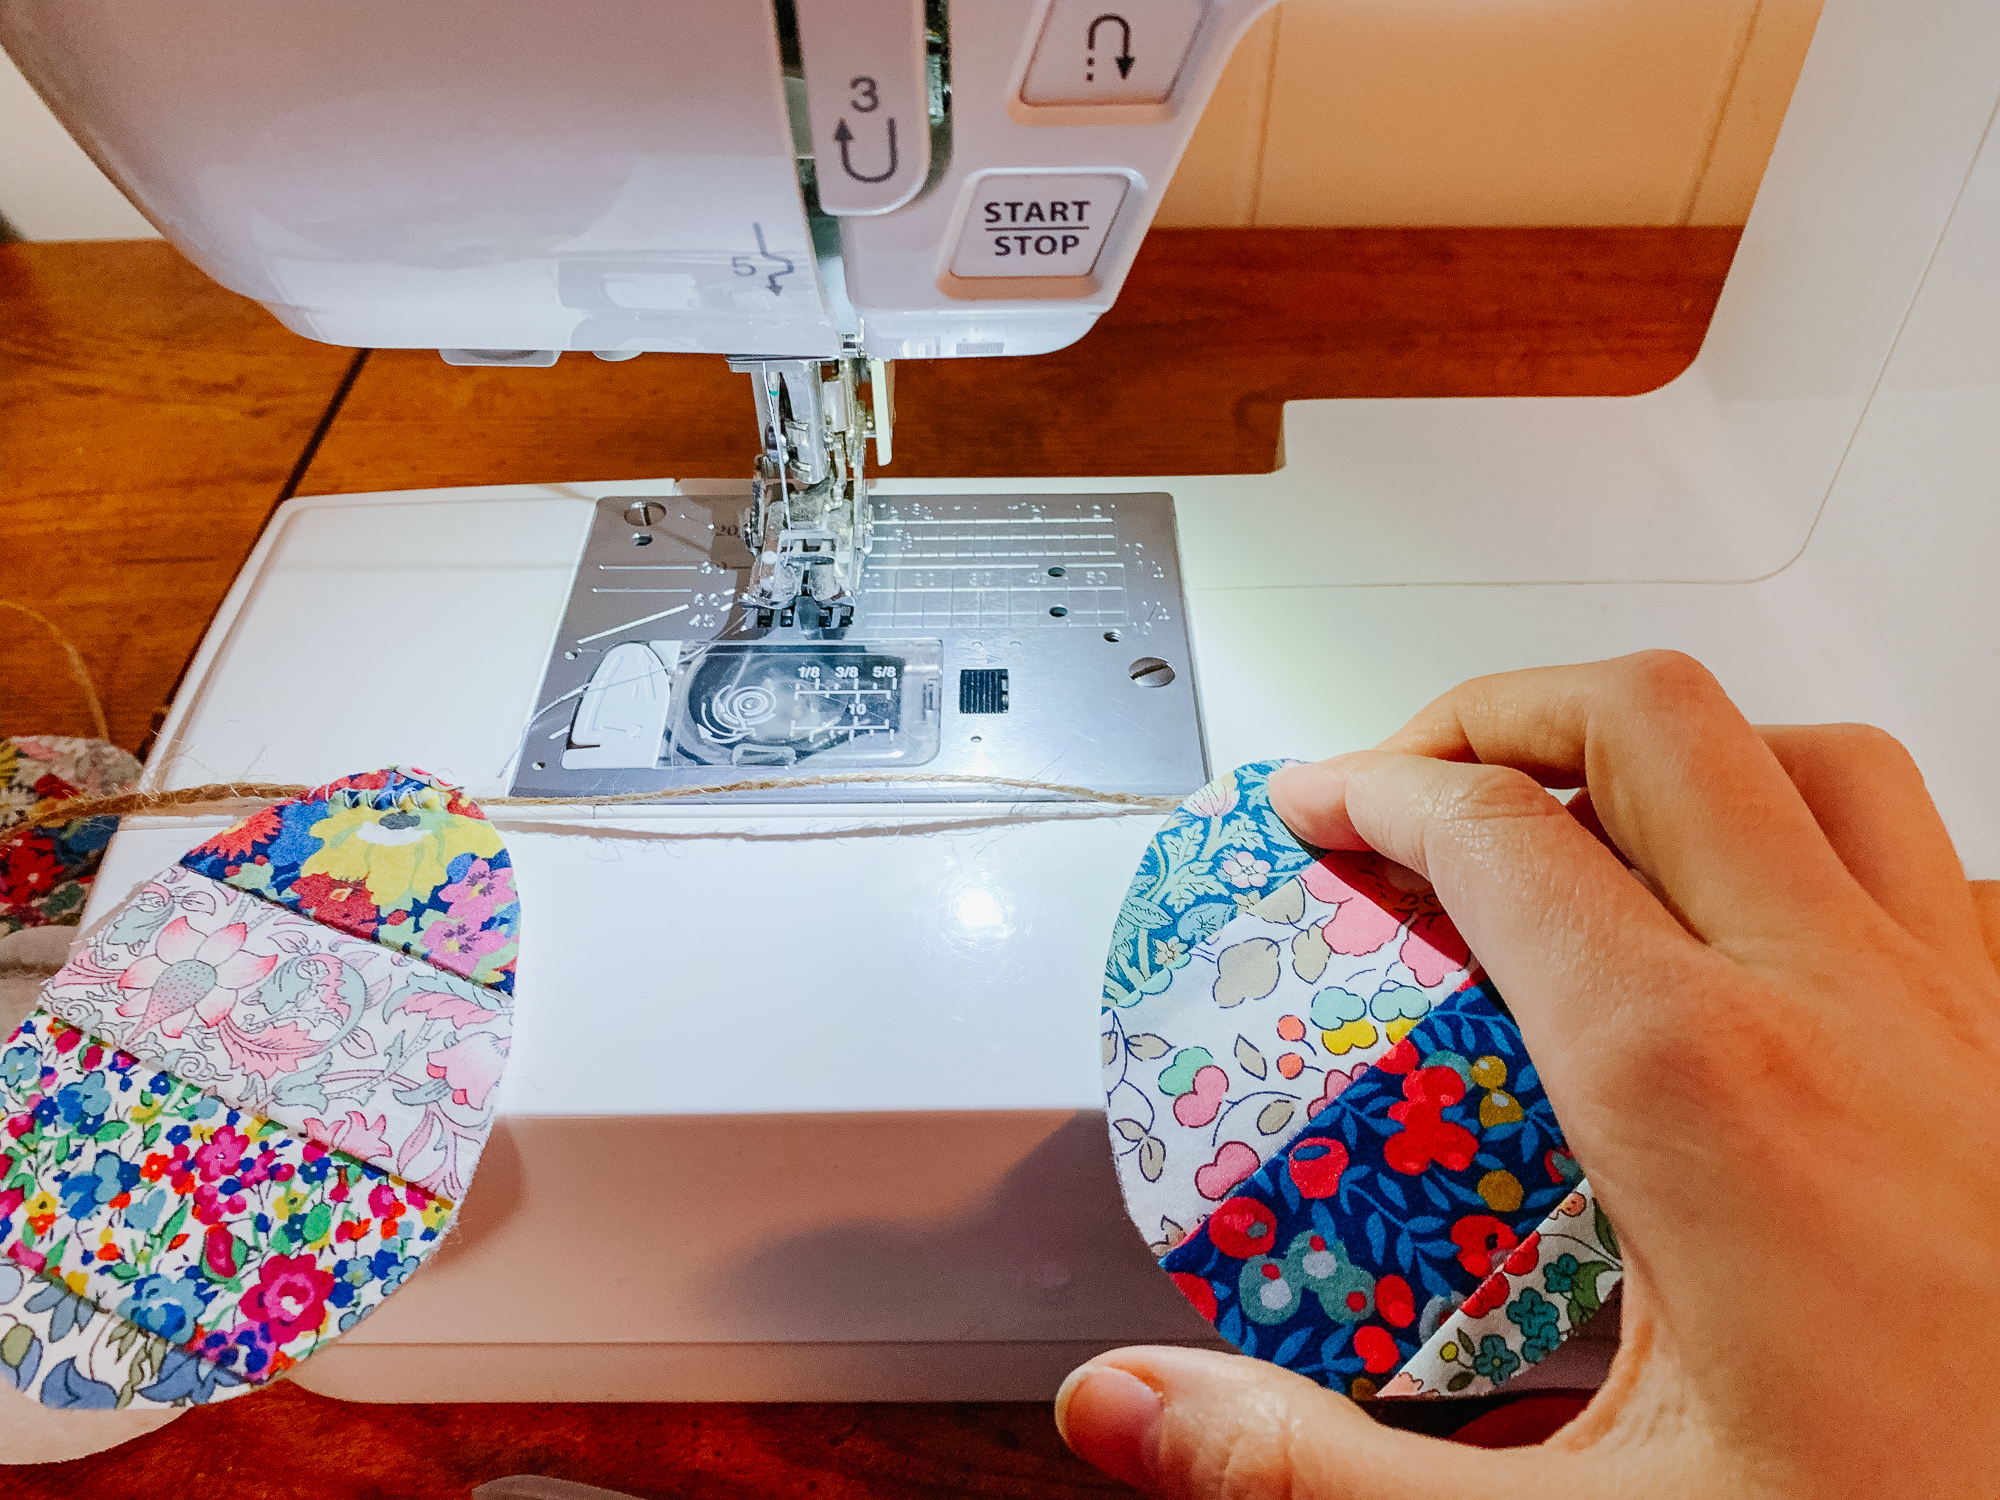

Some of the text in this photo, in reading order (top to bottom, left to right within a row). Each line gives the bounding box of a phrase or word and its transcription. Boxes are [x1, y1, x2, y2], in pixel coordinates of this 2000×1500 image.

[850, 76, 880, 112] 3
[984, 201, 1091, 222] START
[994, 235, 1080, 256] STOP
[731, 256, 756, 277] 5
[798, 666, 897, 679] 1/8 3/8 5/8
[848, 703, 867, 715] 10
